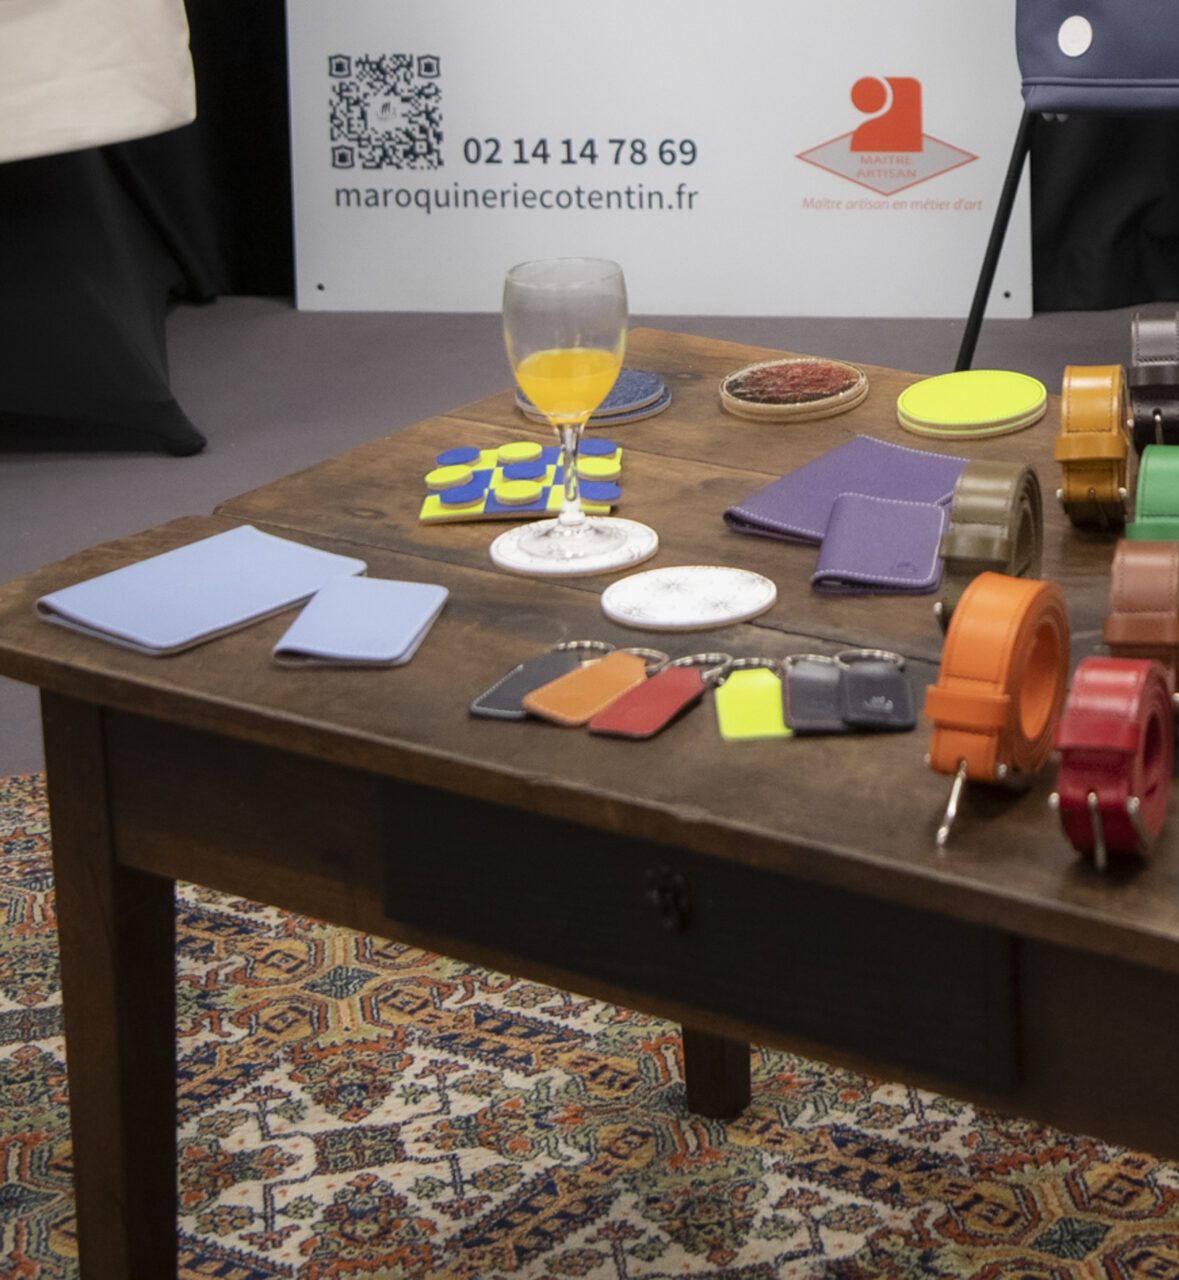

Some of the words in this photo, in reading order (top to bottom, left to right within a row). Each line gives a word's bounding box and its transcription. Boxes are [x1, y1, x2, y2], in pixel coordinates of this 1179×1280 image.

[463, 137, 503, 165] 02
[512, 137, 551, 165] 14
[560, 138, 599, 165] 14
[608, 138, 648, 166] 78
[658, 138, 698, 166] 69
[856, 169, 918, 179] ARTISAN
[334, 181, 698, 215] maroquineriecotentin.fr
[845, 197, 890, 210] artisan
[892, 199, 908, 210] en
